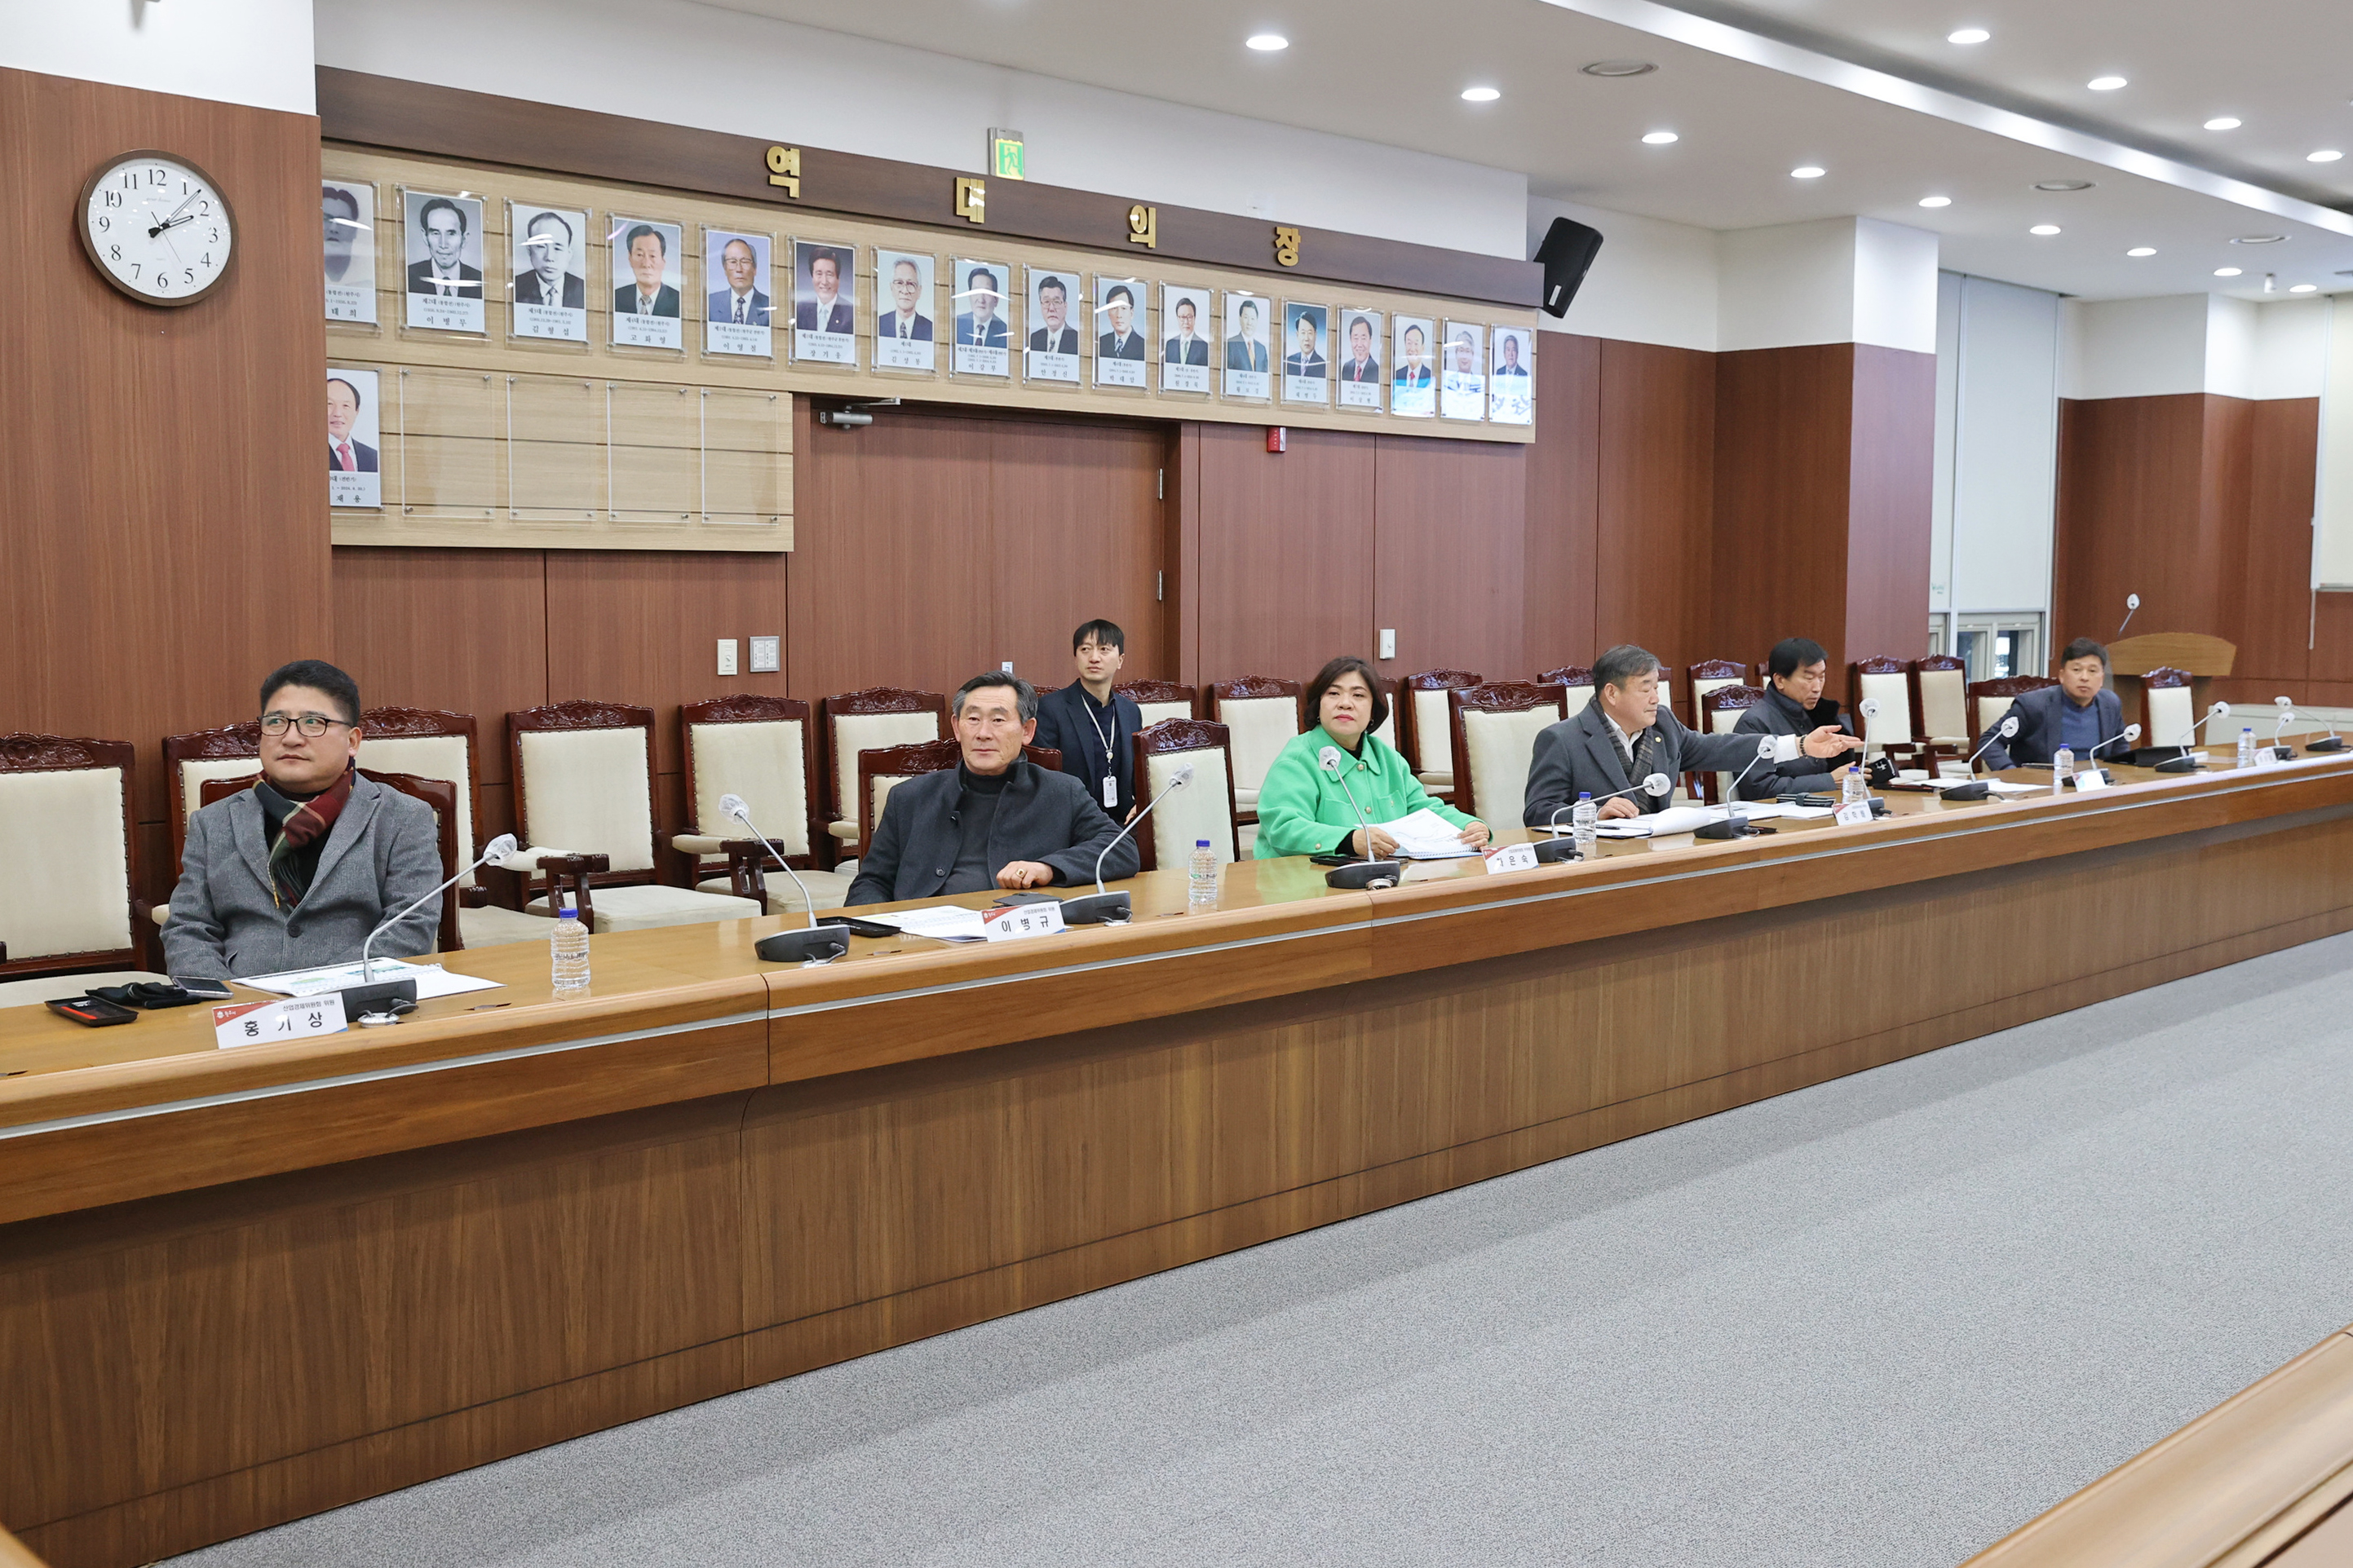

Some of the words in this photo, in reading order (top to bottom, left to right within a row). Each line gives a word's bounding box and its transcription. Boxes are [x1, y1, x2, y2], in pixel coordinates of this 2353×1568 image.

[123, 172, 139, 190] 11
[148, 169, 167, 186] 12
[182, 181, 188, 196] 1
[104, 190, 122, 208] 10
[767, 146, 800, 198] 역
[956, 177, 984, 223] 대
[1130, 205, 1156, 248] 의
[1275, 227, 1301, 267] 장
[198, 200, 210, 218] 2
[99, 215, 110, 233] 9
[208, 227, 219, 244] 3
[111, 244, 122, 262] 8
[200, 252, 212, 268] 4
[130, 263, 141, 280] 7
[157, 272, 168, 289] 6
[184, 267, 194, 285] 5
[283, 1001, 321, 1012] 산업경제위원회
[245, 1021, 259, 1036] 홍
[308, 1012, 322, 1028] 상
